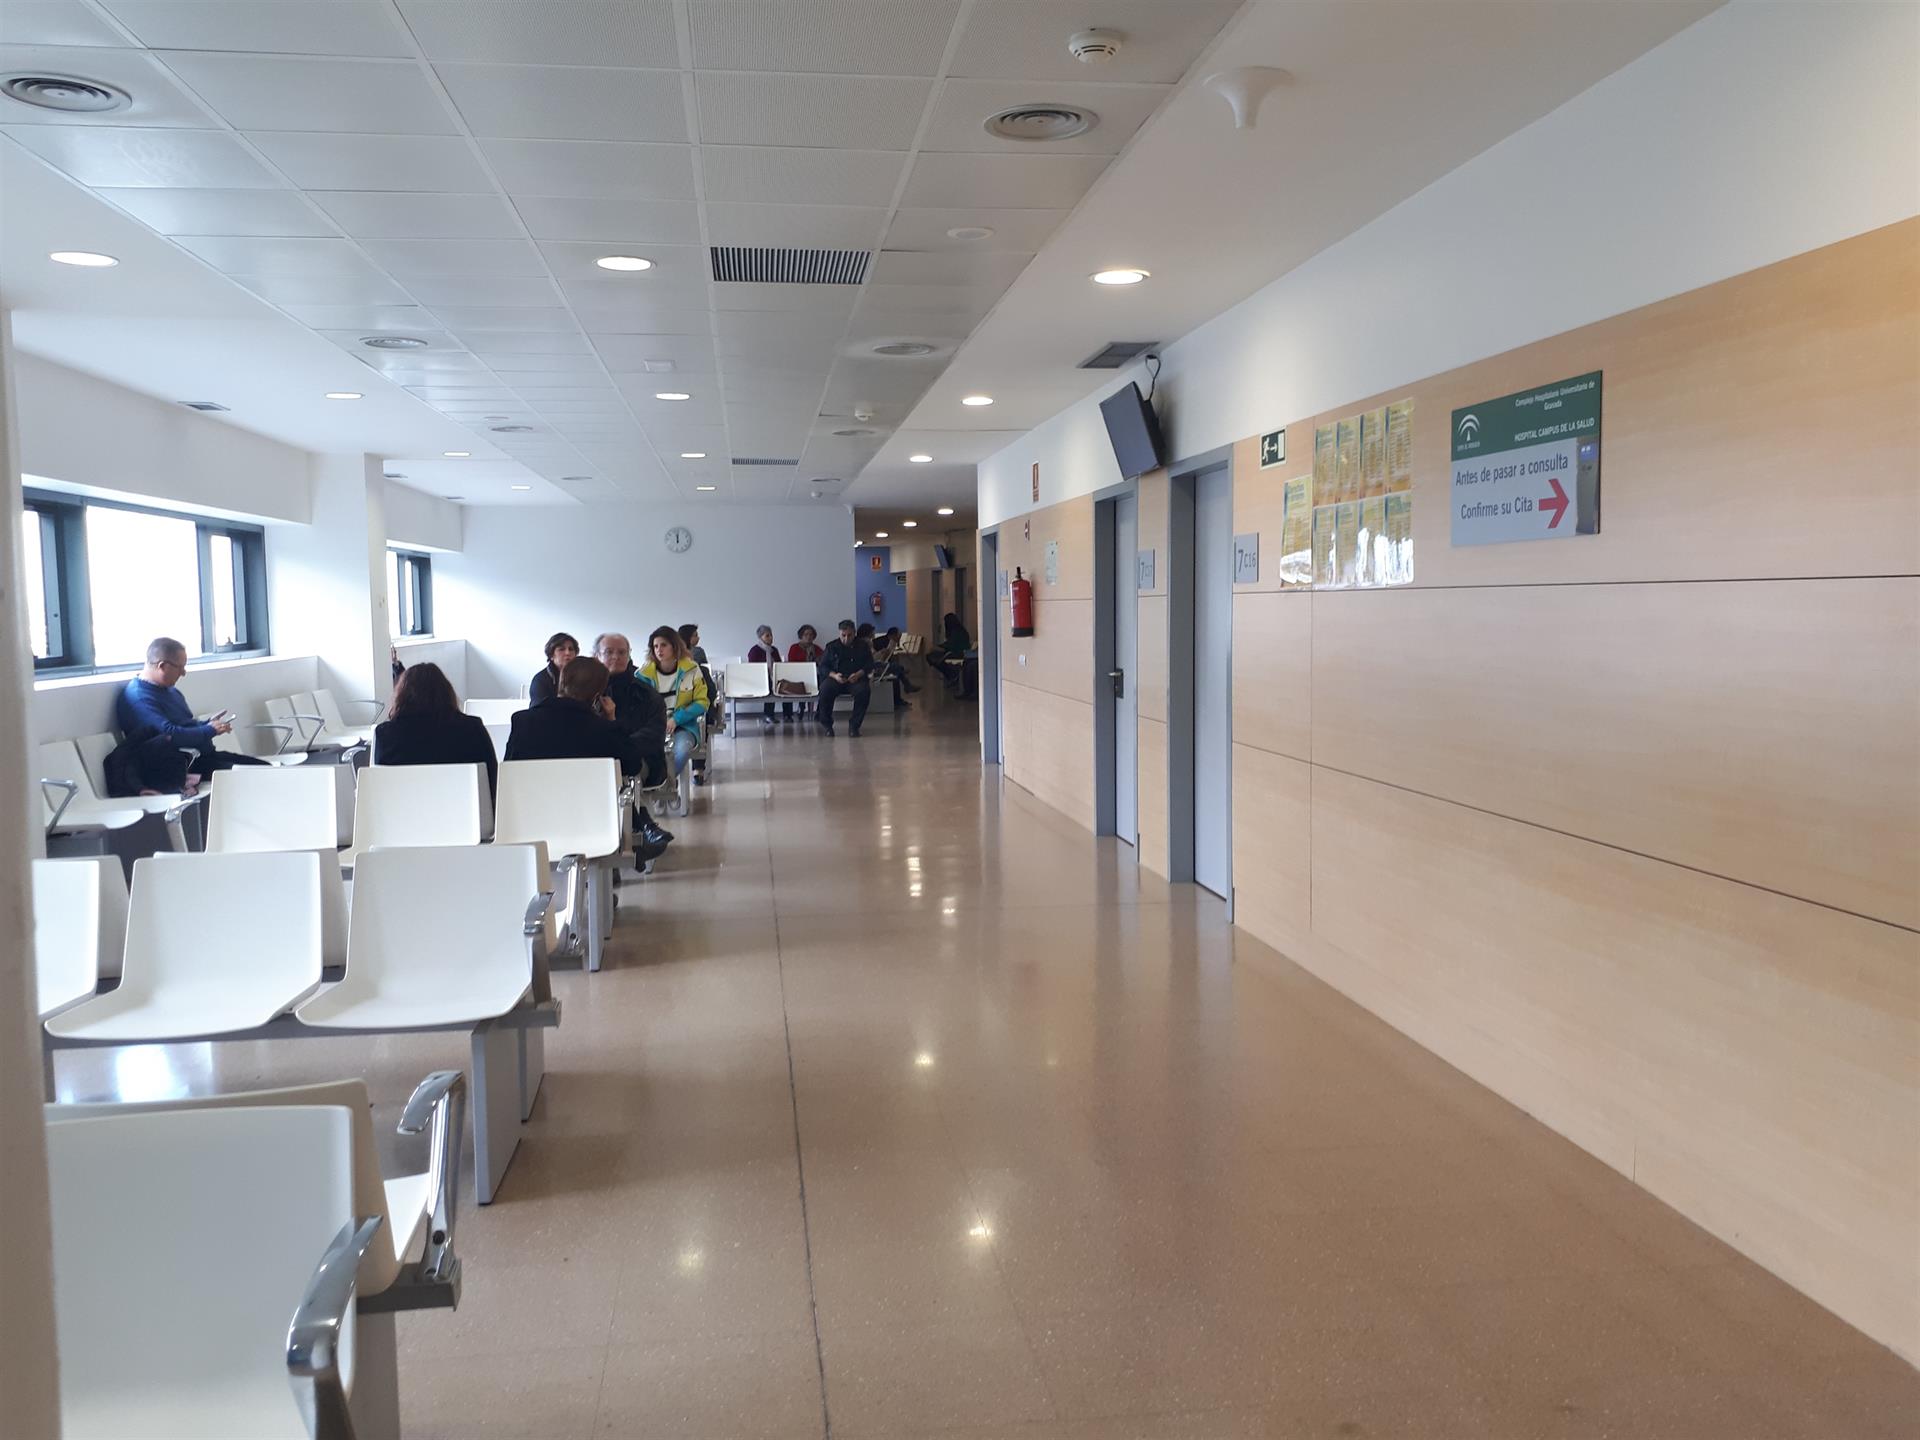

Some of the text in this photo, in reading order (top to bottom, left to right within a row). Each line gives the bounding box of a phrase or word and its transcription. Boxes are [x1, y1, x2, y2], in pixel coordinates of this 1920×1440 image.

[1588, 380, 1595, 389] de
[1514, 417, 1595, 442] HOSPITAL CAMPUS DE LA SALUD
[1455, 452, 1568, 486] Antes de pasar a consulta
[1461, 496, 1533, 520] Confirme su Cita
